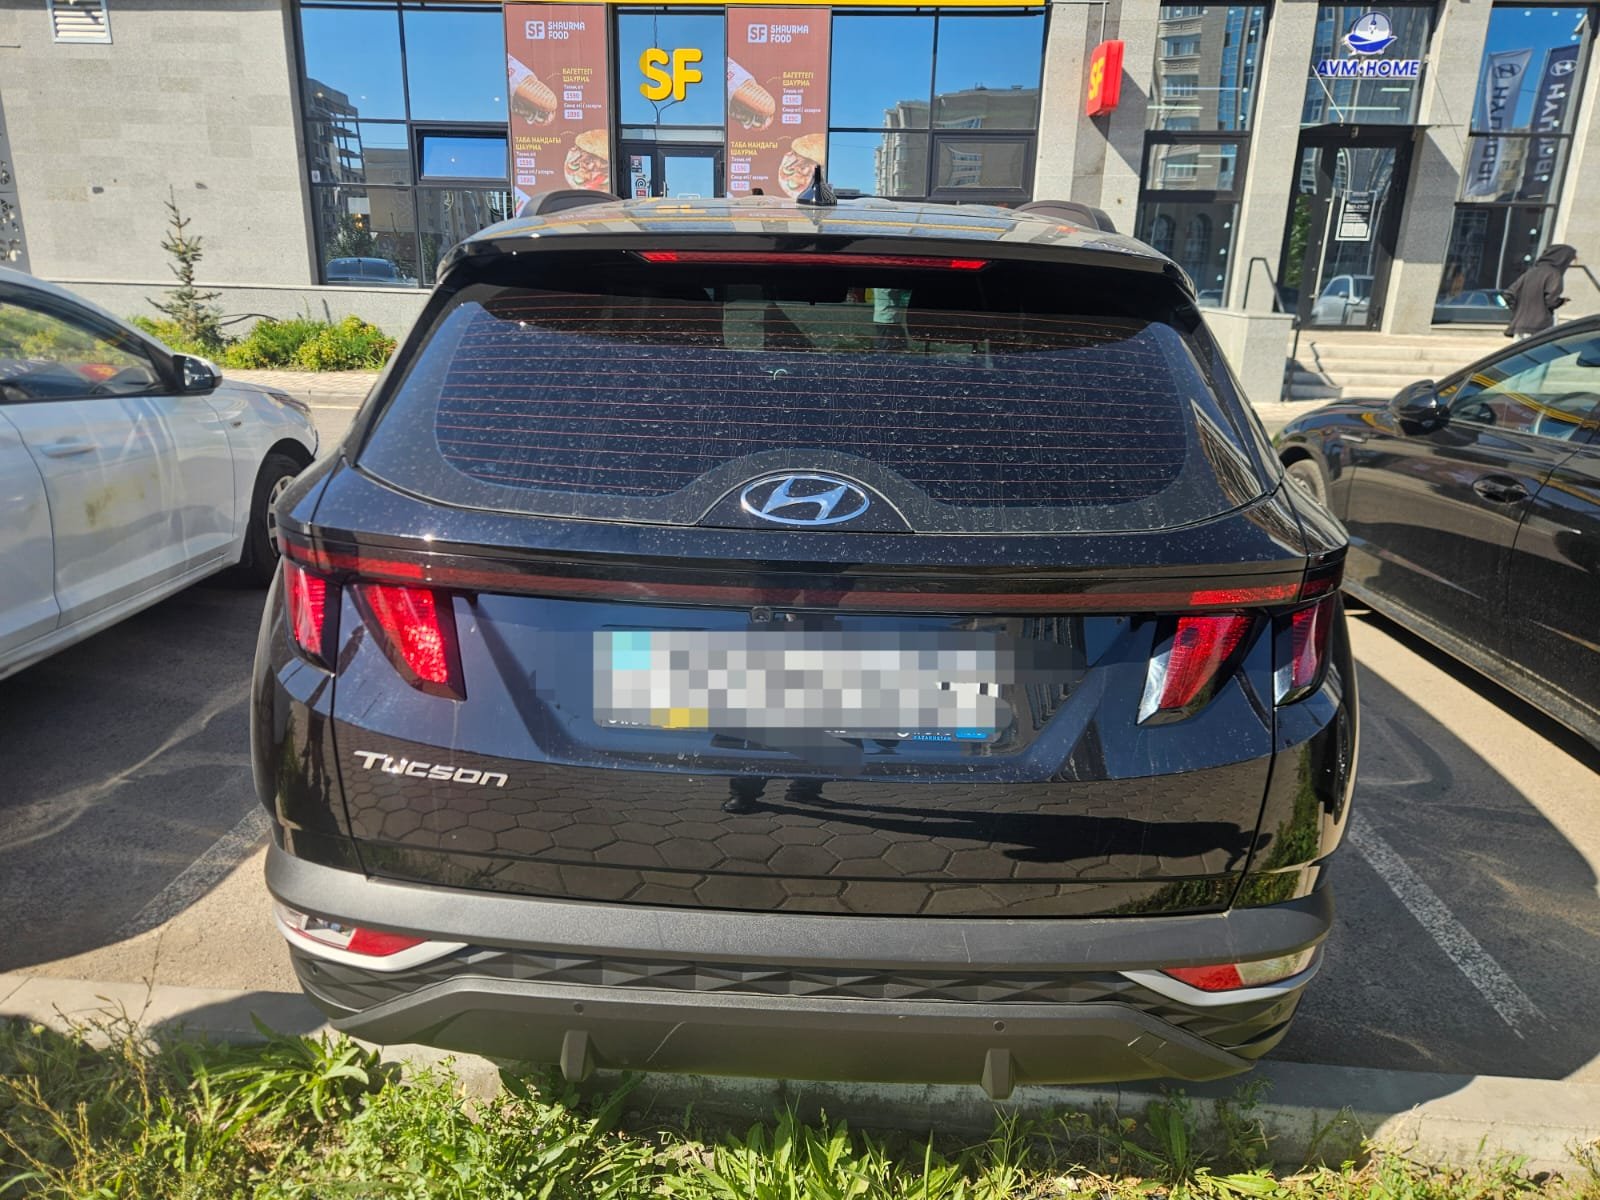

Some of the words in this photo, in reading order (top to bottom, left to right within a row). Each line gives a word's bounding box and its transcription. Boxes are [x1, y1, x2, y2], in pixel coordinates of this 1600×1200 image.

[527, 23, 543, 37] SF
[548, 31, 569, 39] FOOD
[750, 27, 766, 40] SF
[770, 35, 792, 43] FOOD
[639, 47, 703, 101] SF
[1088, 56, 1105, 100] SF
[354, 750, 508, 787] TUCSON
